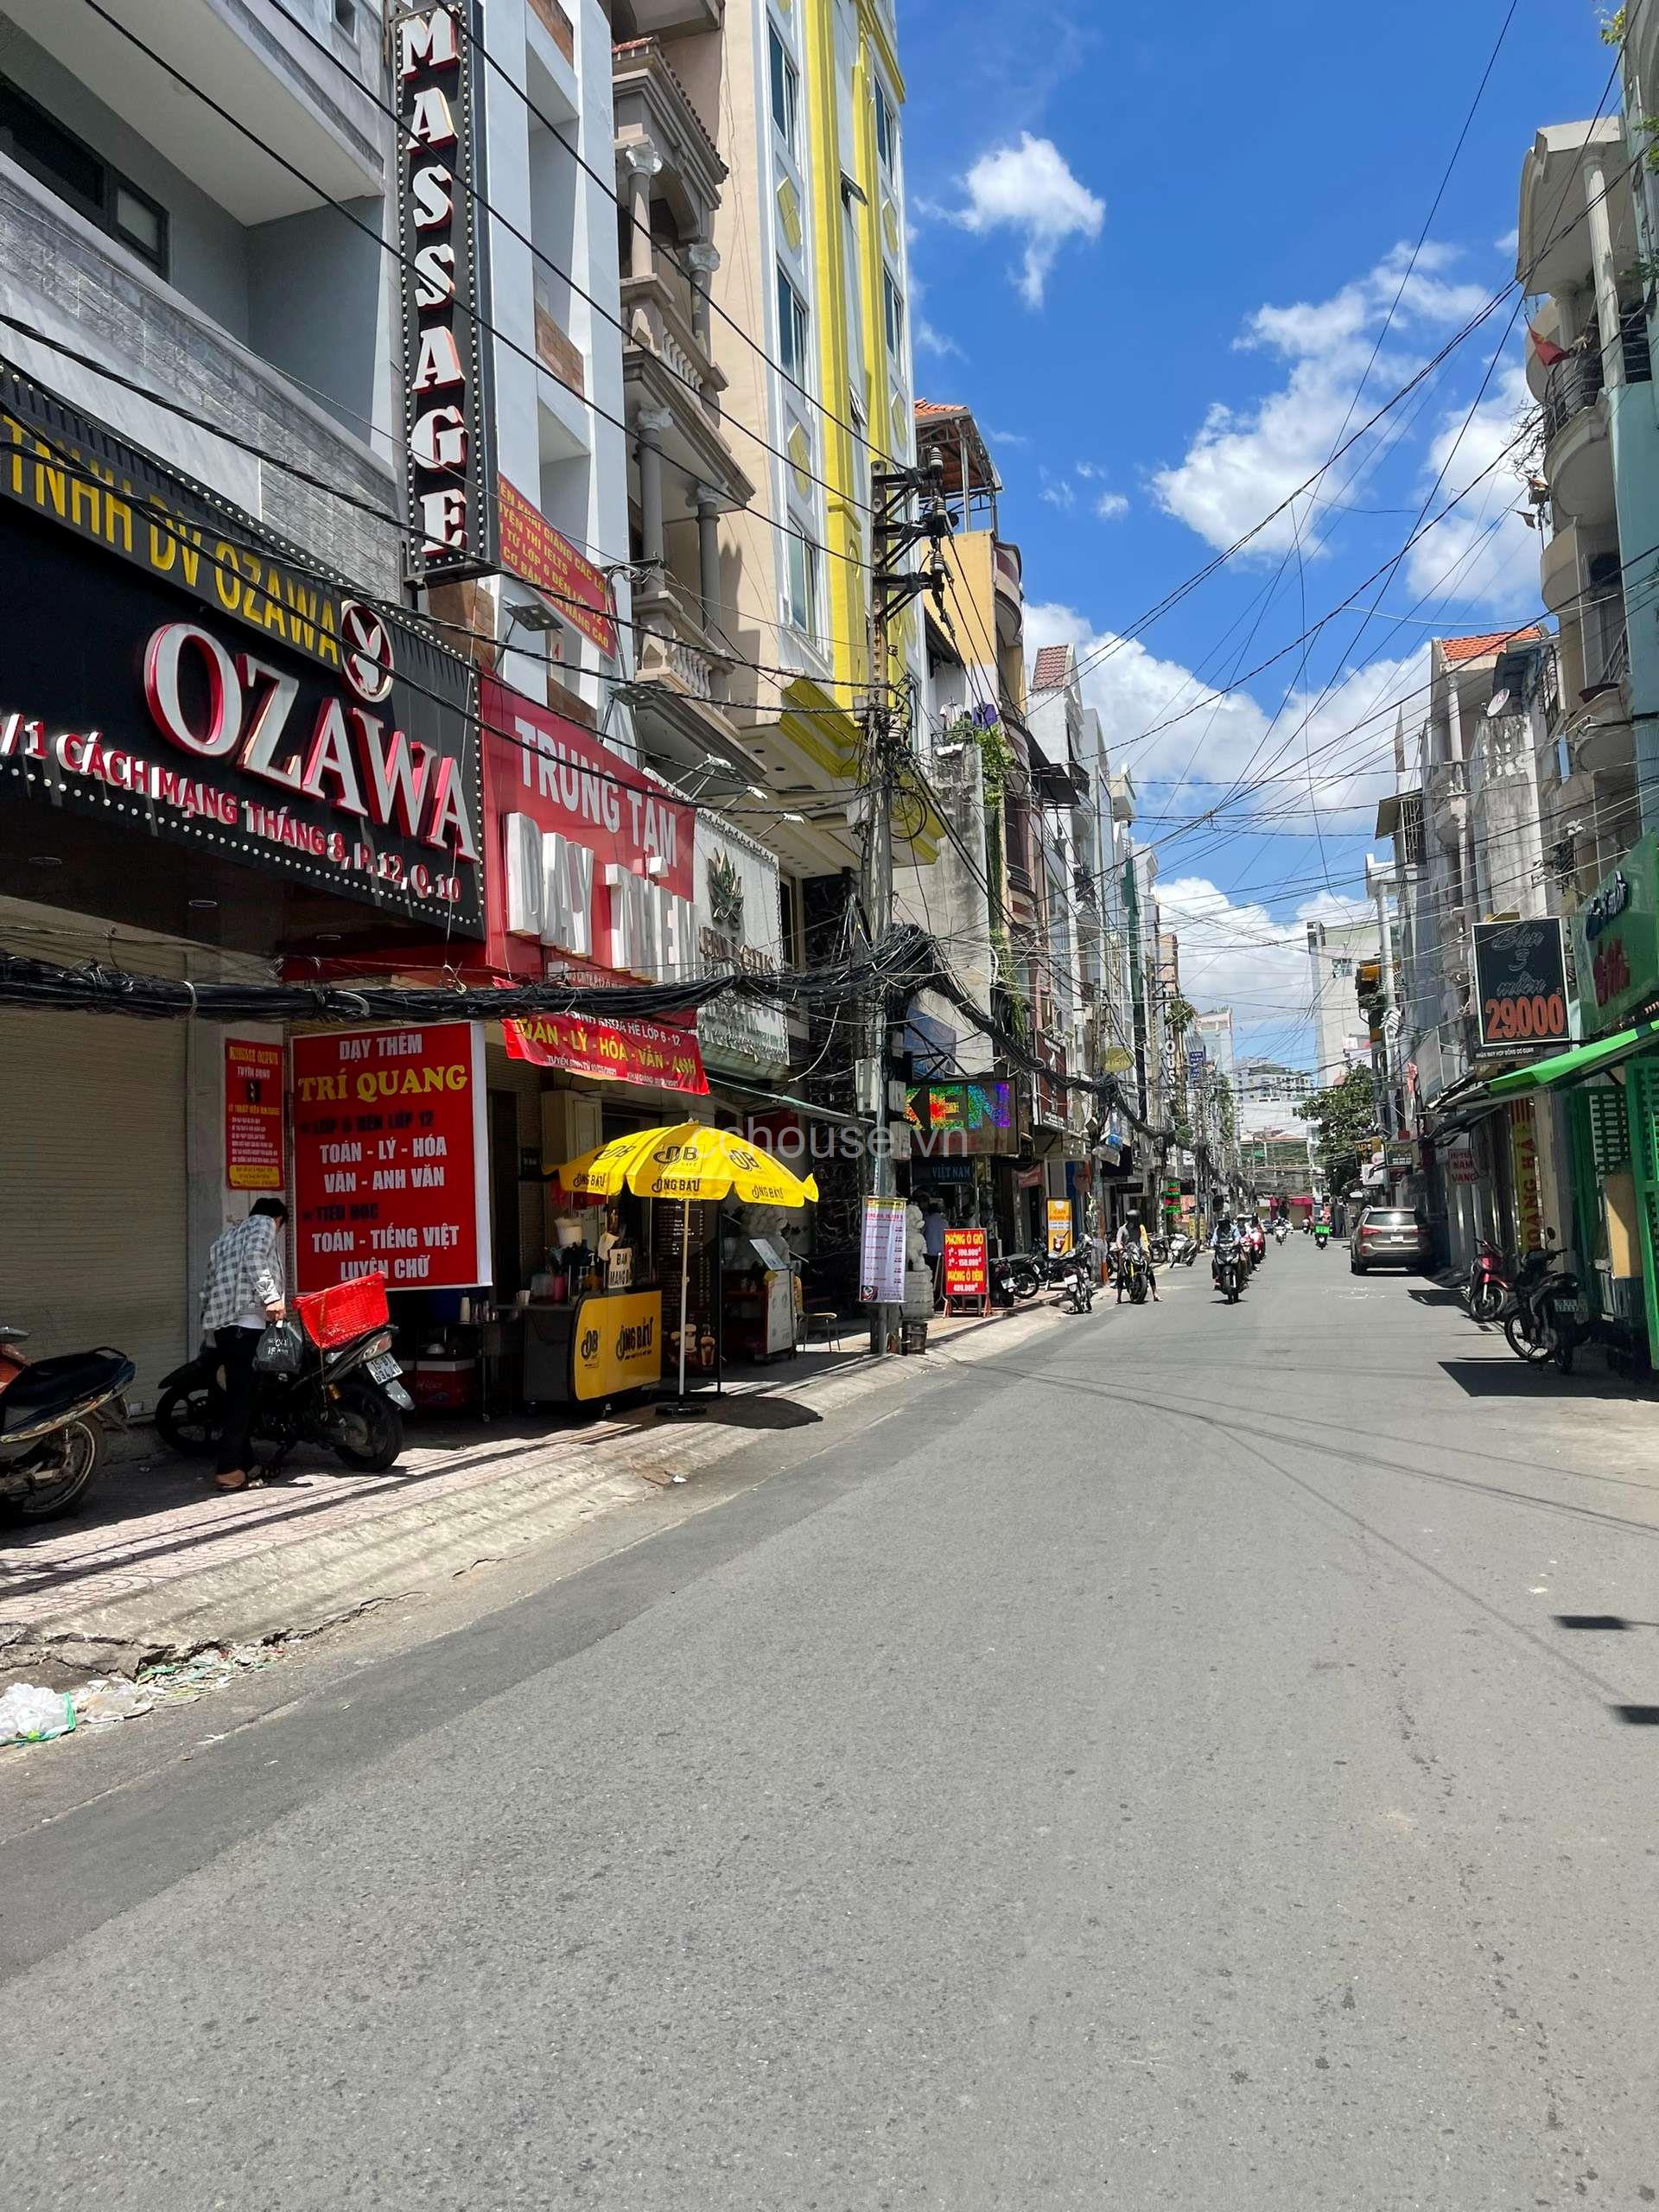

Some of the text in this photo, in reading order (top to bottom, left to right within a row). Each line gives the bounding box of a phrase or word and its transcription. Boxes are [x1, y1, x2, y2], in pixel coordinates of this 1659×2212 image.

[397, 4, 467, 557] MASSAGE
[525, 525, 542, 550] THI
[543, 545, 569, 575] IELTS
[213, 540, 339, 665] OZAWA
[143, 622, 481, 864] OZAWA
[55, 731, 149, 794] CÁCH
[150, 766, 238, 825] MẠNG
[241, 799, 327, 855] THÁNG
[514, 716, 678, 868] TRUNG TÂM
[340, 1033, 423, 1063] DẠY THÊM
[571, 1027, 588, 1052] LÝ
[599, 1033, 628, 1062] HÓA
[641, 1025, 659, 1044] LỚP
[660, 1032, 667, 1045] 6
[298, 1064, 467, 1103] TRÍ QUANG
[320, 1139, 362, 1165] TOÁN
[378, 1138, 397, 1161] LÝ
[412, 1135, 448, 1159] HÓA
[324, 1169, 357, 1194] VĂN
[372, 1168, 407, 1191] ANH
[411, 1166, 445, 1189] VĂN
[312, 1228, 354, 1253] TOÁN
[370, 1222, 419, 1250] TIẾNG
[423, 1224, 461, 1249] VIỆT
[394, 1254, 431, 1280] CHỮ
